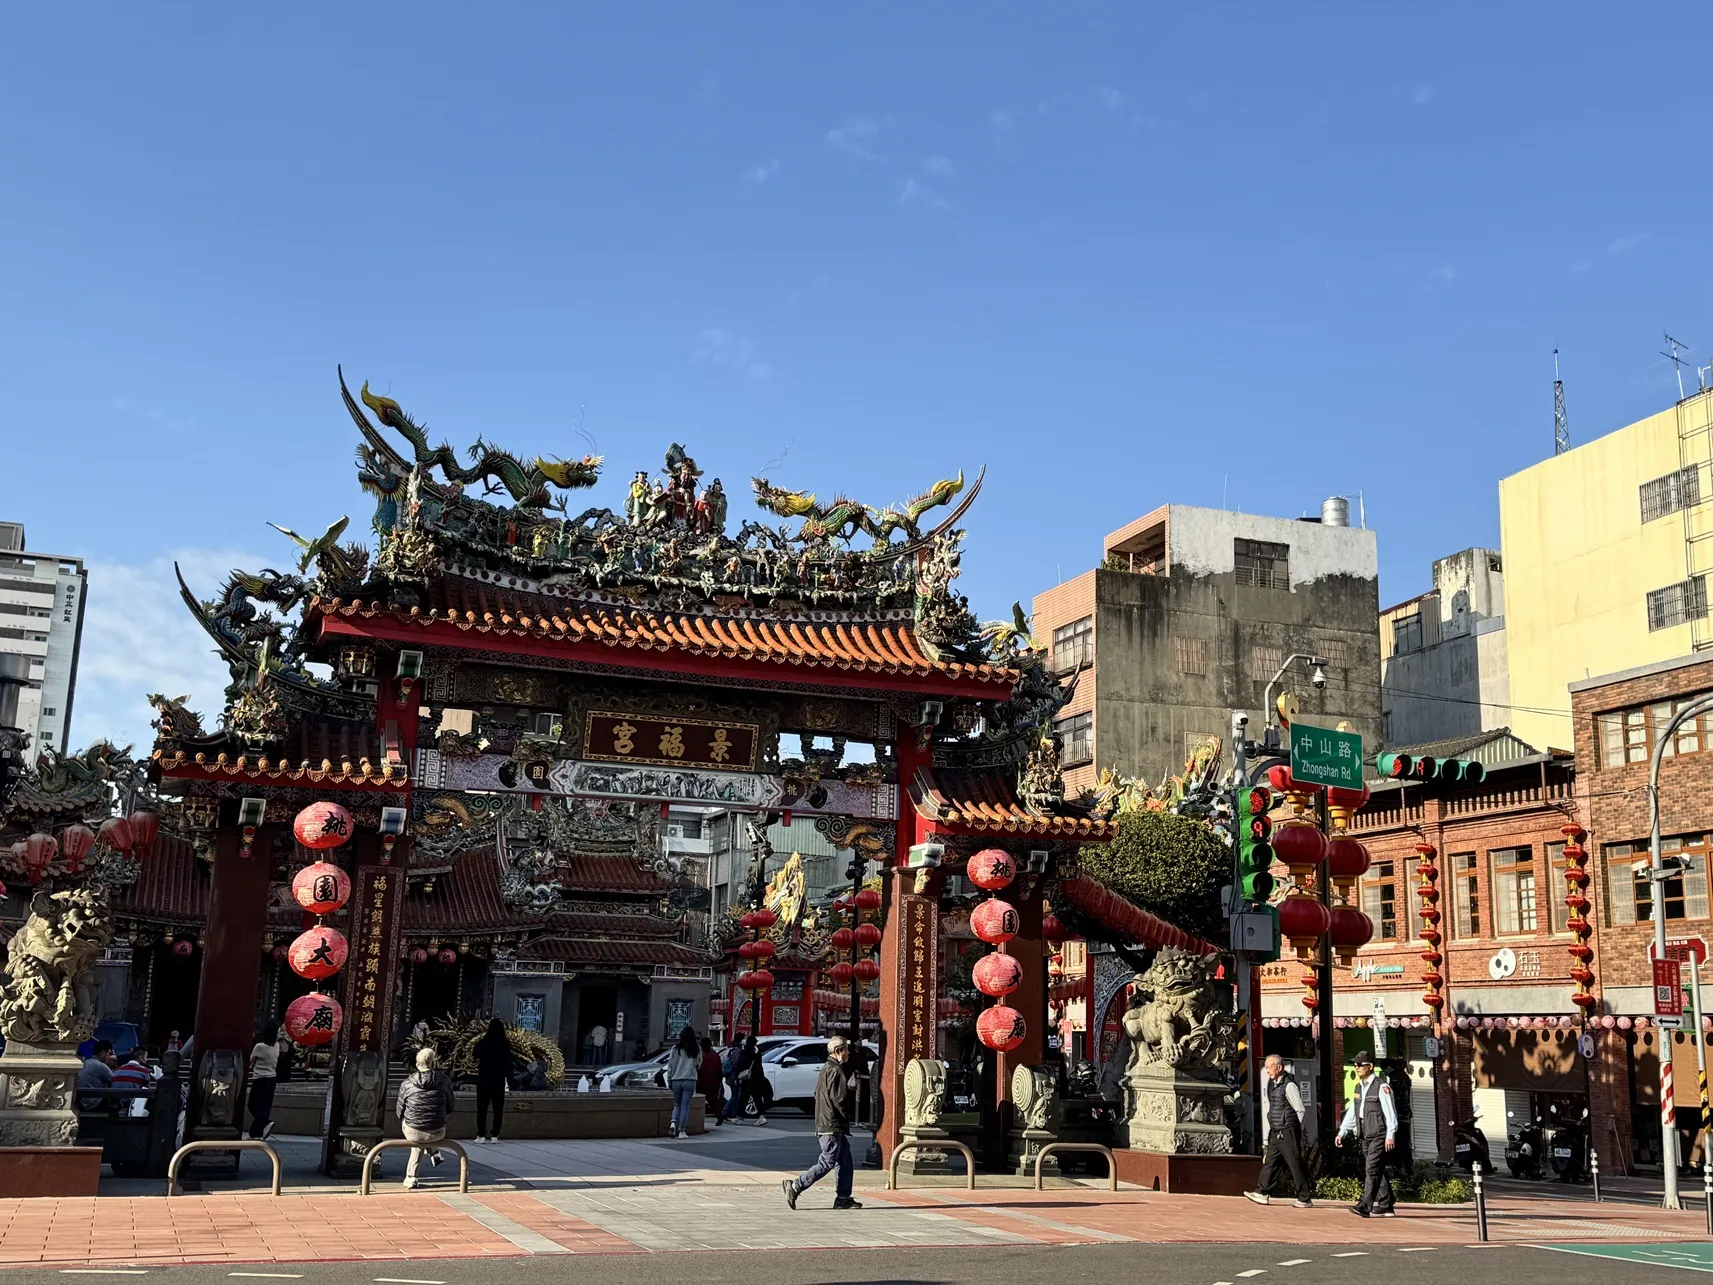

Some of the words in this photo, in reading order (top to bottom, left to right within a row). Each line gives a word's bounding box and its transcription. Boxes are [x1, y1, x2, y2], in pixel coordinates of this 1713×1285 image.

[612, 721, 733, 762] 景福宮
[1300, 734, 1352, 759] 中山路
[533, 765, 543, 780] 園
[1302, 760, 1339, 779] Zhongshan
[786, 784, 798, 796] 桃
[1518, 950, 1540, 964] 石玉
[1352, 959, 1379, 982] Apple
